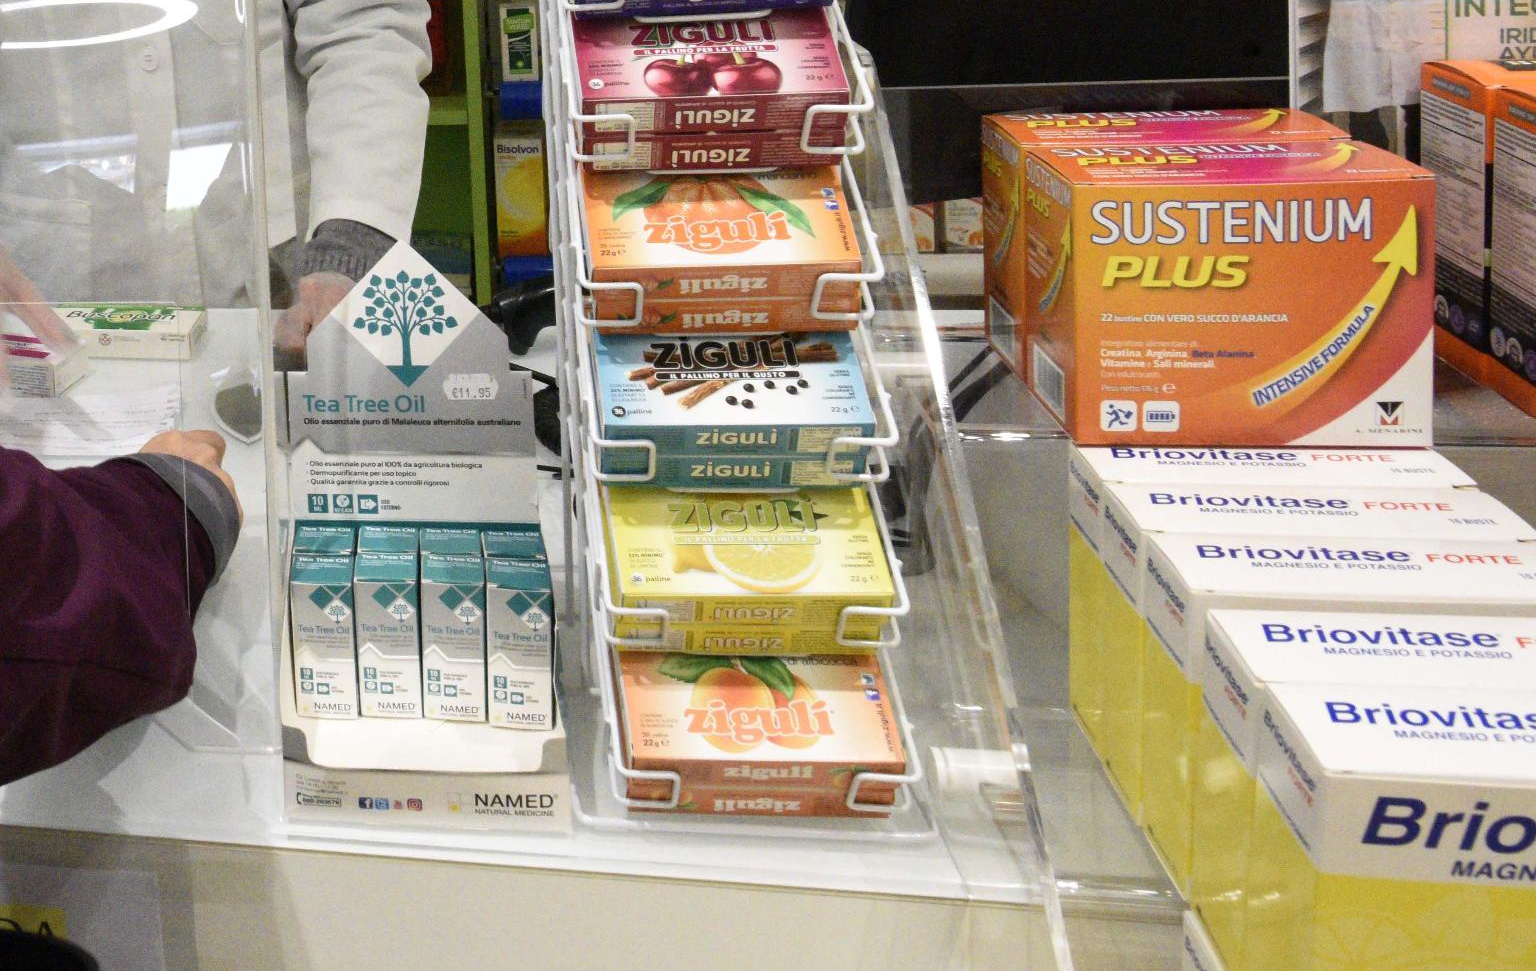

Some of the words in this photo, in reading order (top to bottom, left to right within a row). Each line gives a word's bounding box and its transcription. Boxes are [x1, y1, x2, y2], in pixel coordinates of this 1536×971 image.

[497, 143, 539, 156] Bisolvon
[1091, 197, 1372, 246] SUSTENIUM
[1101, 255, 1250, 288] PLUS
[66, 308, 177, 323] Buscopan
[1101, 313, 1113, 322] 22
[1144, 314, 1165, 323] CON
[1167, 314, 1195, 323] VERO
[1197, 314, 1230, 323] SUCCO
[1231, 313, 1288, 323] D'ARANCIA
[1252, 357, 1322, 407] INTENSIVE
[1321, 304, 1375, 364] FORMULA
[742, 371, 751, 379] IL
[451, 387, 492, 399] €11.95
[302, 394, 341, 413] Tea
[344, 394, 390, 413] Tree
[394, 394, 426, 414] Oil
[303, 417, 320, 426] Olio
[321, 417, 361, 426] essenziale
[362, 418, 381, 427] puro
[382, 417, 390, 426] di
[391, 417, 432, 427] Melaleuca
[433, 417, 475, 427] alternifolia
[476, 417, 521, 427] australiano
[309, 460, 323, 468] Olio
[324, 460, 359, 468] essenziale
[360, 461, 376, 469] puro
[384, 460, 402, 468] 100%
[403, 460, 412, 468] da
[413, 460, 450, 470] agricoltura
[451, 461, 483, 470] biologica
[1149, 492, 1350, 510] Briovitase
[1363, 500, 1455, 512] FORTE
[1196, 544, 1412, 563] Briovitase
[1425, 552, 1524, 565] FORTE
[1251, 560, 1328, 570] MAGNESIO
[1334, 562, 1343, 570] E
[1347, 562, 1423, 572] POTASSIO
[1262, 623, 1502, 649] Briovitase
[475, 794, 554, 809] NAMED
[475, 808, 513, 816] NATURAL
[514, 809, 555, 817] MEDICINE
